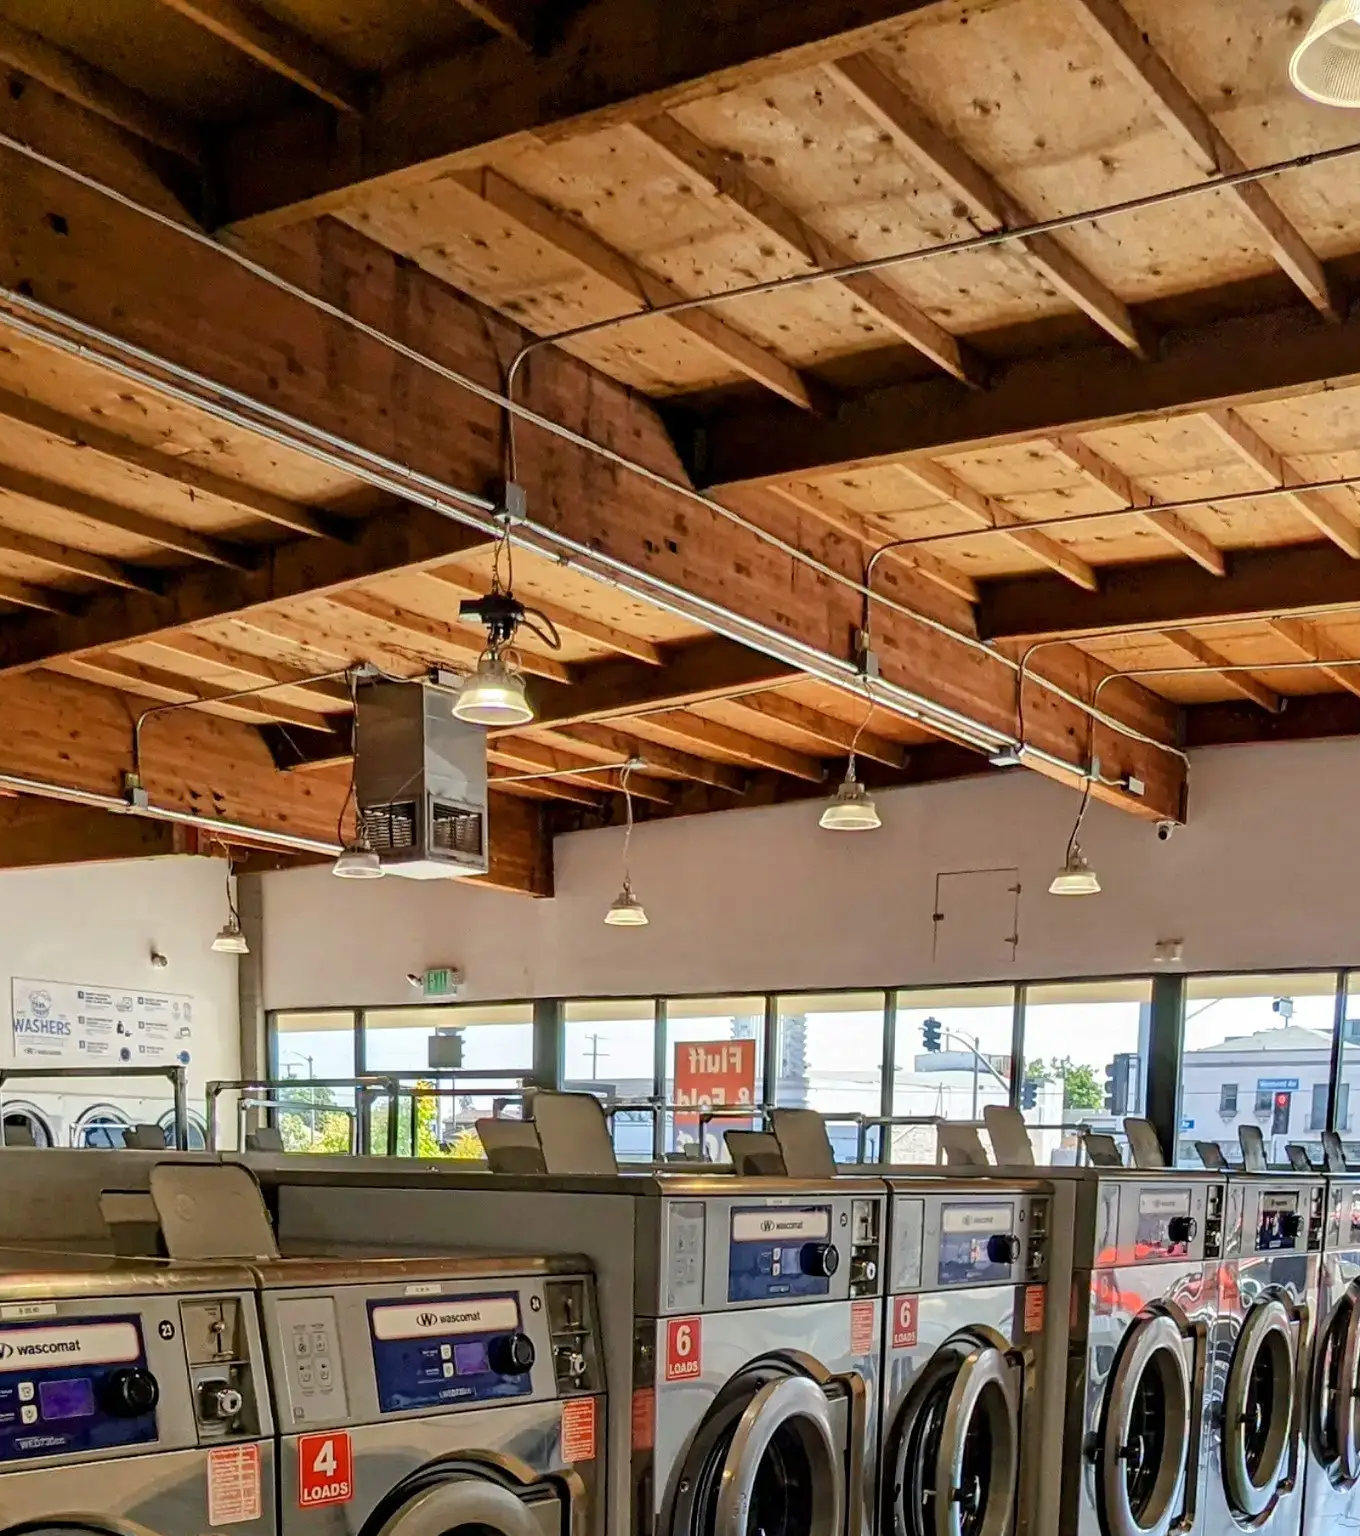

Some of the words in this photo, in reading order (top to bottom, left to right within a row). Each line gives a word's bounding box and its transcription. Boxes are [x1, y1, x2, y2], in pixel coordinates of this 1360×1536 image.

[13, 1017, 72, 1036] WASHERS
[439, 1311, 481, 1325] wascomat
[899, 1301, 911, 1328] 6
[676, 1324, 691, 1357] 6
[893, 1331, 917, 1343] LOADS
[16, 1339, 81, 1357] wascomat
[668, 1361, 699, 1376] LOADS
[312, 1439, 337, 1477] 4
[303, 1481, 349, 1501] LOADS
